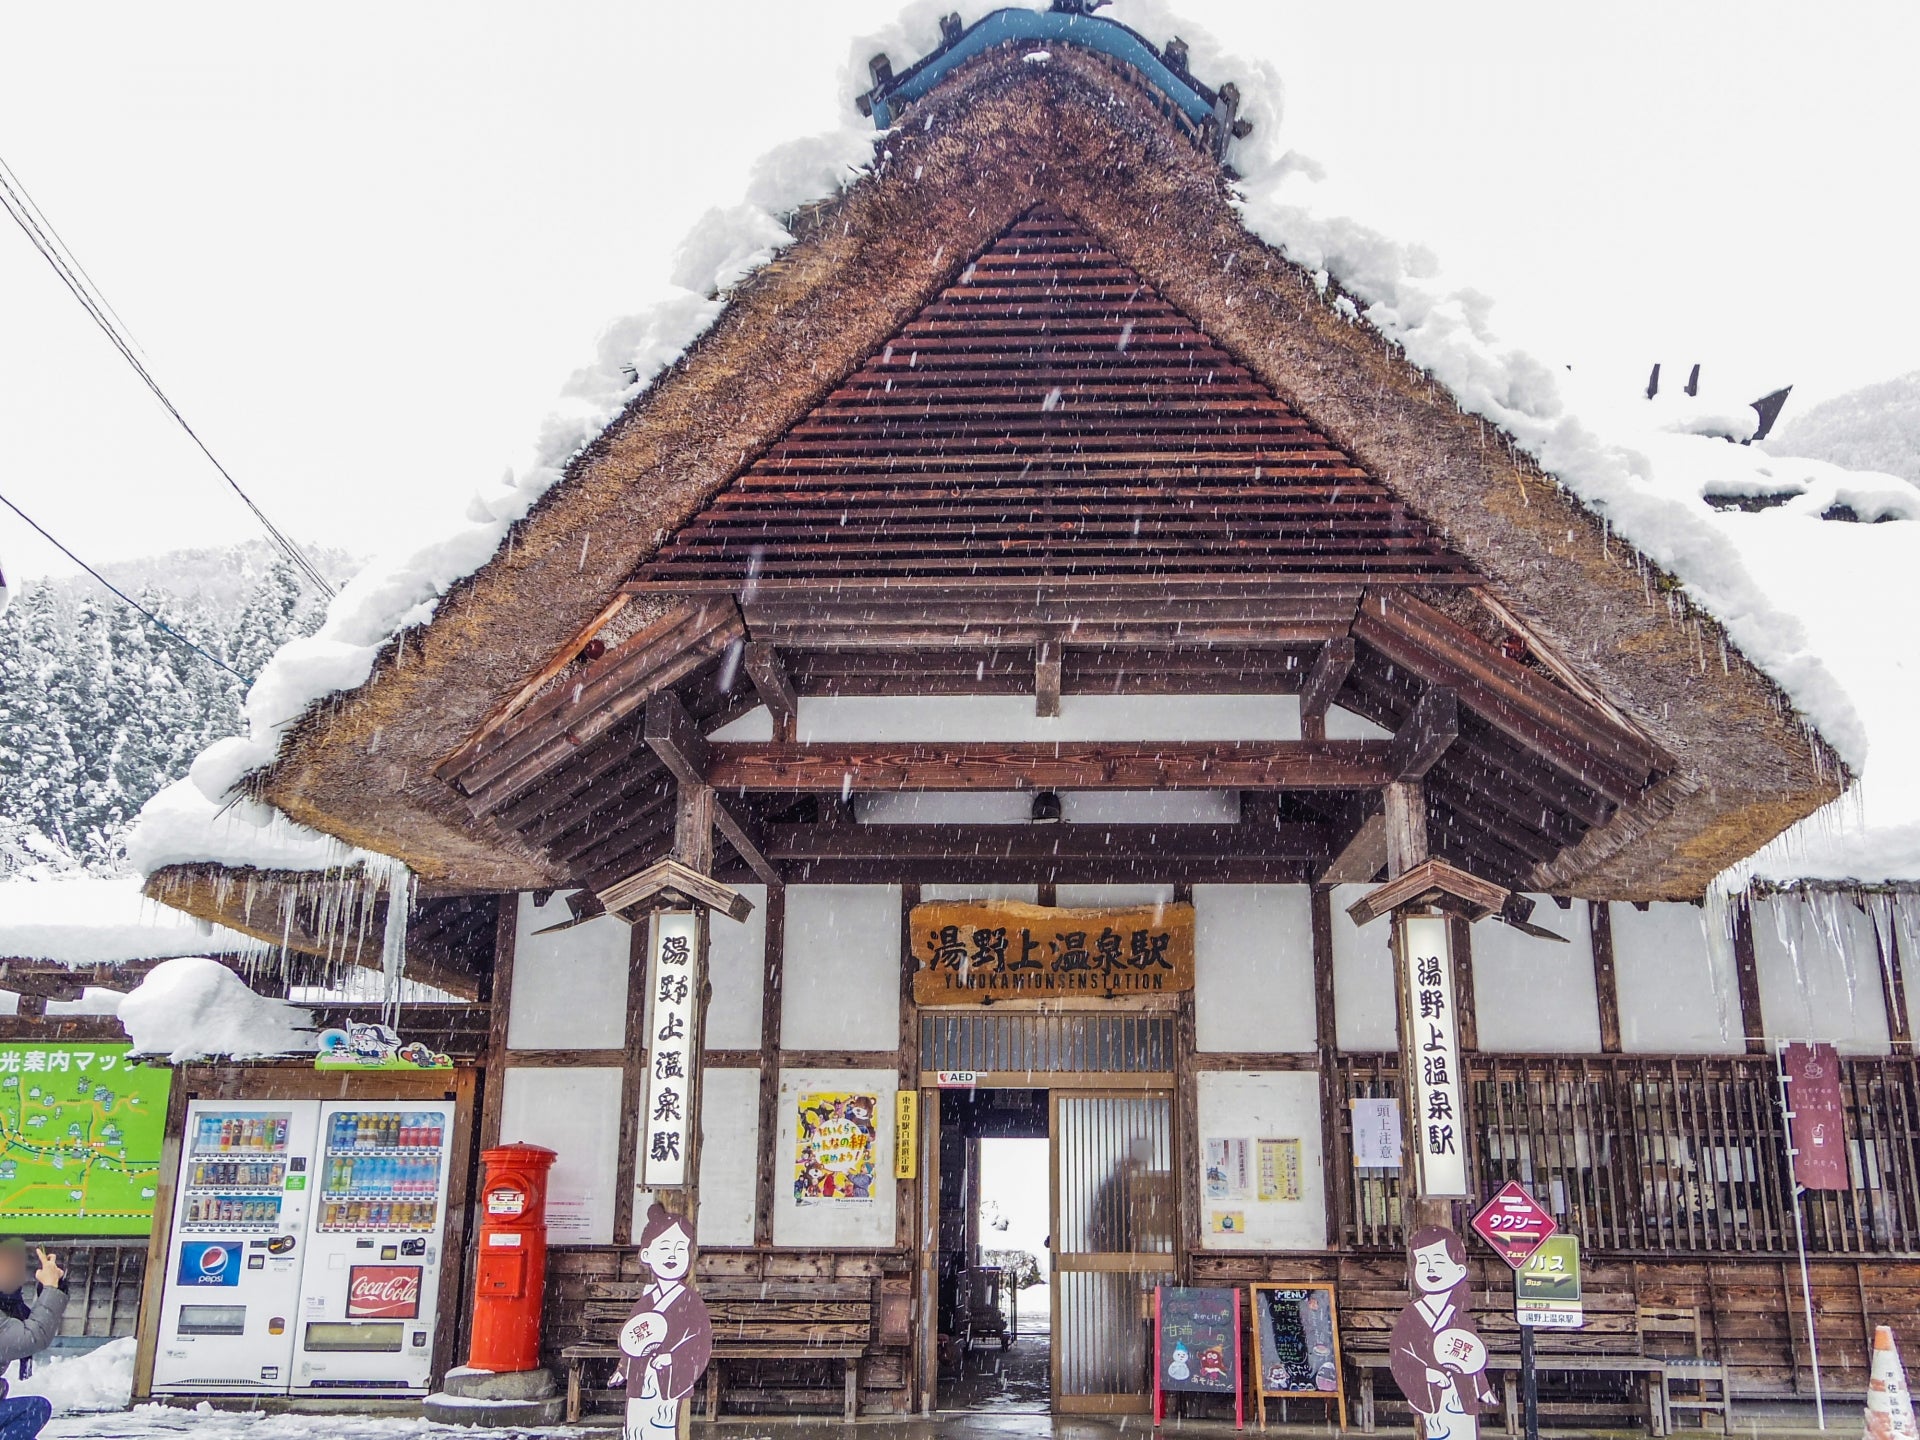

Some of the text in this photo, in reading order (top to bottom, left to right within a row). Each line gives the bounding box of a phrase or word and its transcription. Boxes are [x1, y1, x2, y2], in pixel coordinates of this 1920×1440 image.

[927, 925, 1174, 975] 湯野上温泉駅
[650, 936, 690, 1162] 湯野上温泉駅
[1417, 956, 1455, 1155] 湯野上温泉駅
[950, 1073, 973, 1082] AED
[1377, 1104, 1393, 1159] 頭上注意
[811, 1134, 867, 1151] みんなの絆
[1489, 1213, 1542, 1229] タクシー
[1505, 1250, 1527, 1258] Taxi
[1529, 1255, 1564, 1270] バス
[198, 1274, 224, 1284] pepsi
[1277, 1290, 1306, 1299] MENU
[1525, 1312, 1574, 1323] 湯野上温泉駅
